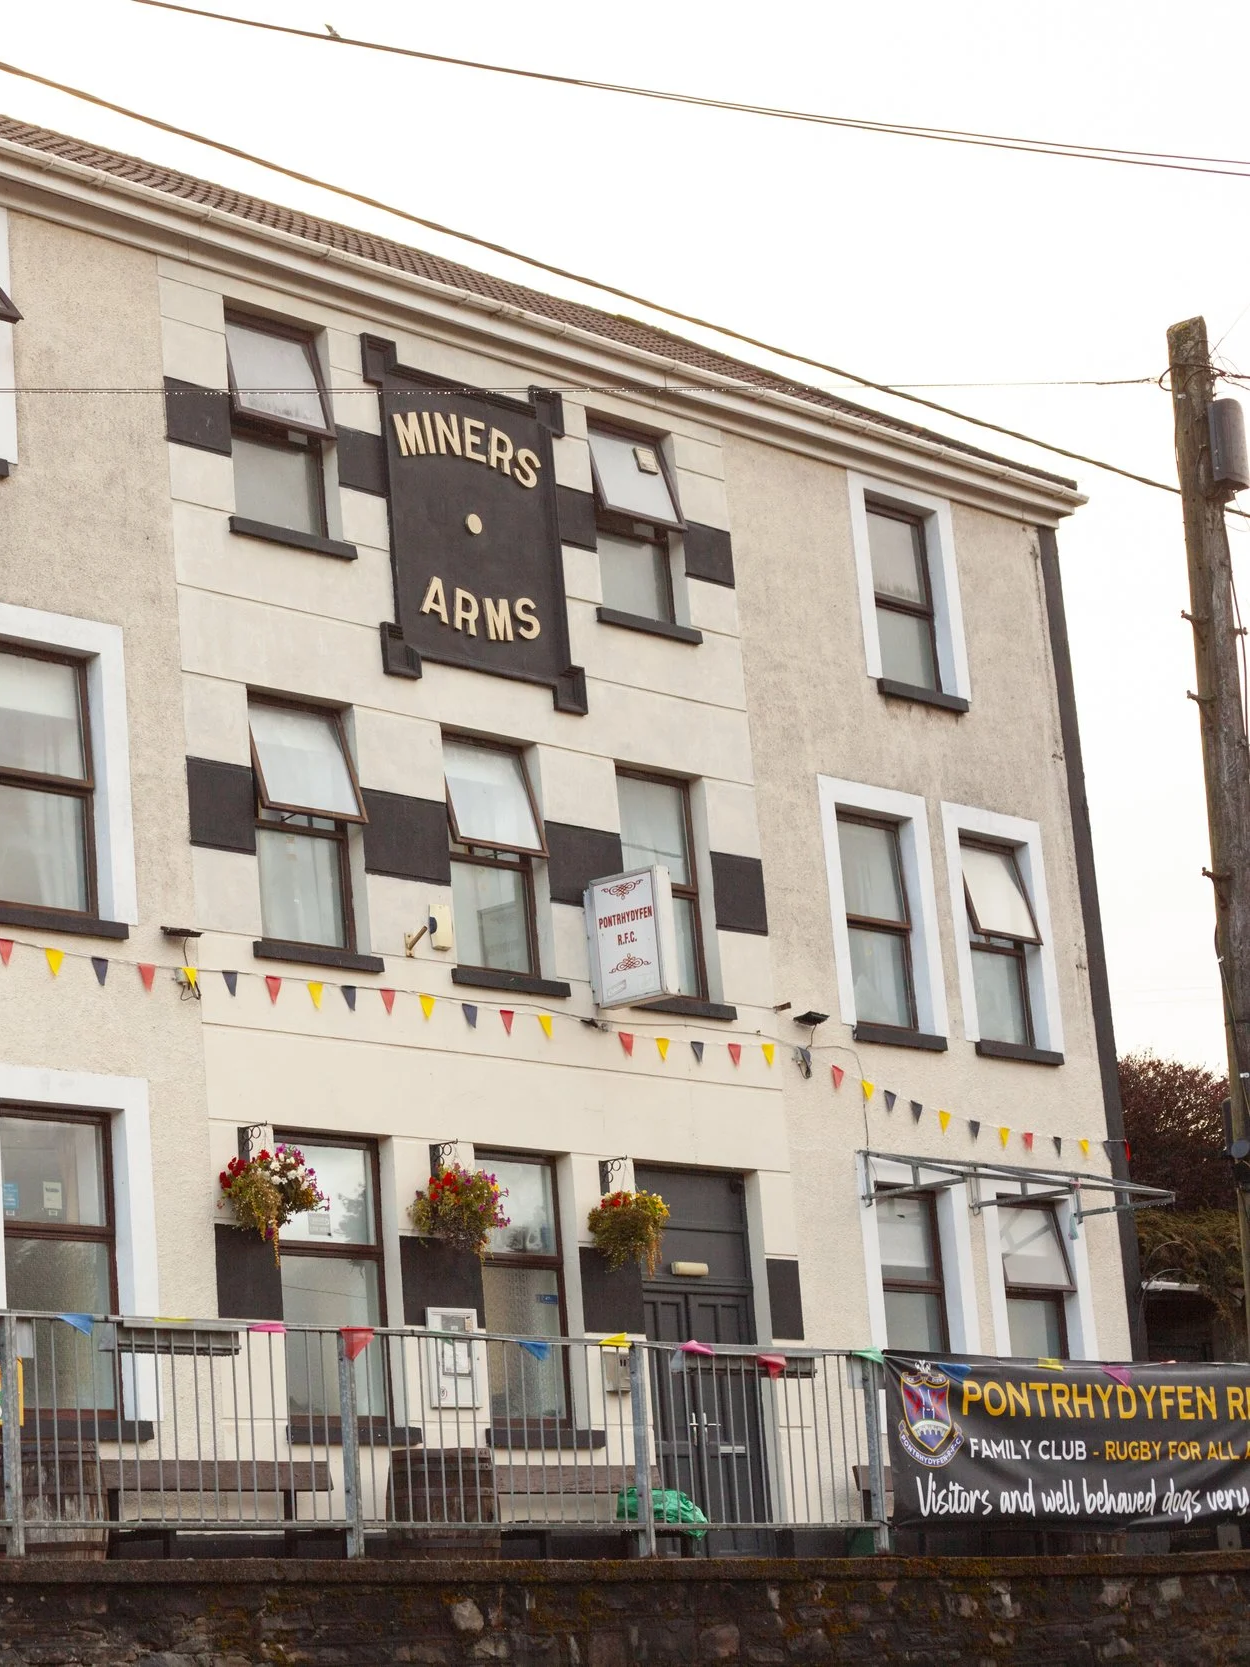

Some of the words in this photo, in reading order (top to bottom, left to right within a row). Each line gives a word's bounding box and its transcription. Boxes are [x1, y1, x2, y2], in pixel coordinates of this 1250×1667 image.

[392, 411, 542, 489] MINERS
[419, 575, 541, 641] ARMS
[598, 905, 653, 930] PONTRHYDYFEN
[617, 931, 638, 946] R.F.C.
[962, 1381, 1218, 1421] PONTRHYDYFEN
[970, 1438, 1032, 1460] FAMILY
[1038, 1440, 1087, 1461] CLUB
[1105, 1441, 1163, 1461] RUGBY
[1168, 1441, 1202, 1461] FOR
[1207, 1441, 1240, 1461] ALL
[916, 1472, 993, 1517] Visitors
[1000, 1478, 1036, 1517] and
[1041, 1478, 1080, 1516] well
[1083, 1478, 1156, 1516] behaved
[1162, 1478, 1202, 1524] dogs
[1207, 1486, 1250, 1517] very
